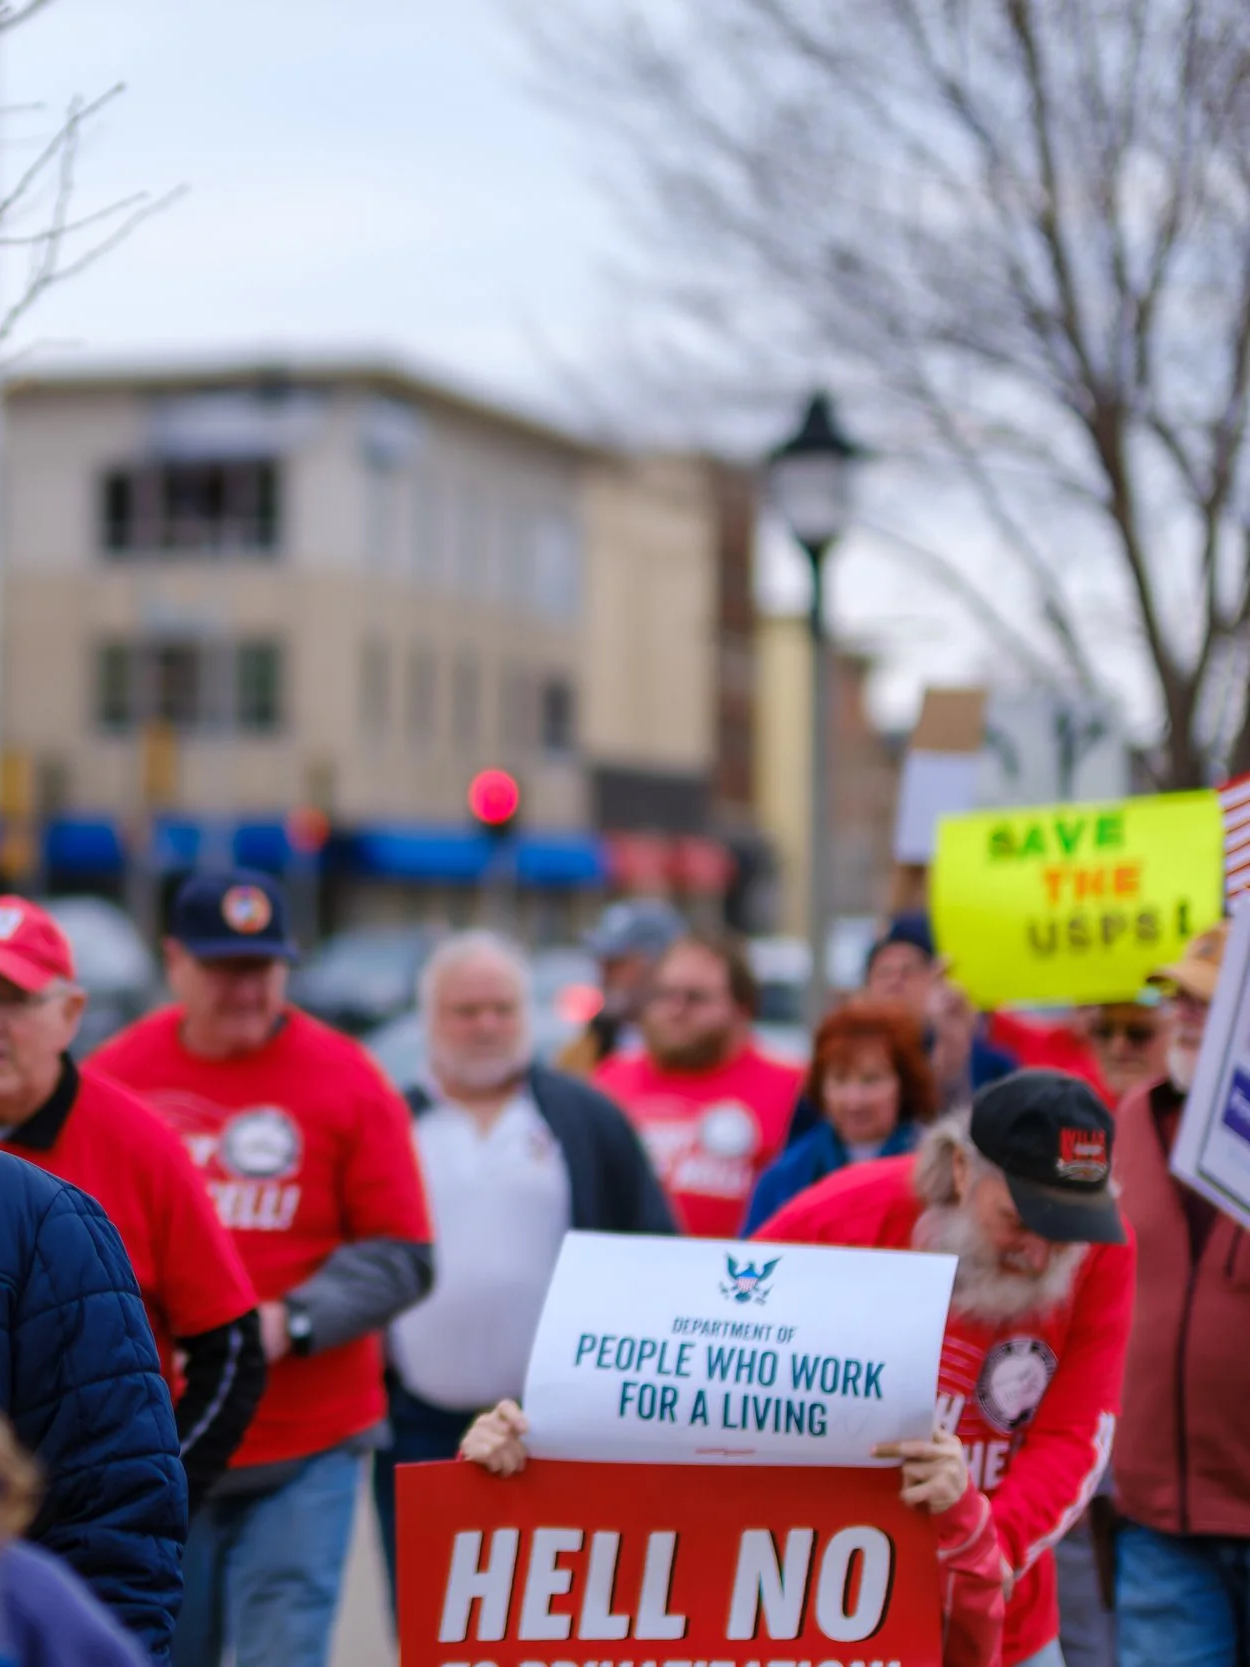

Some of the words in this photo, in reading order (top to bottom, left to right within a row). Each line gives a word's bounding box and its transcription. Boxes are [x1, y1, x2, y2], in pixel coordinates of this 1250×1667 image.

[989, 815, 1125, 860] SAVE
[1045, 864, 1139, 905] THE
[672, 1316, 771, 1344] DEPARTMENT
[777, 1325, 798, 1345] OF
[573, 1332, 695, 1378] PEOPLE
[706, 1344, 779, 1388] WHO
[791, 1352, 887, 1400] WORK
[618, 1380, 679, 1424] FOR
[689, 1388, 709, 1427] A
[722, 1391, 829, 1438] LIVING
[437, 1527, 688, 1643] HELL
[725, 1525, 896, 1643] NO
